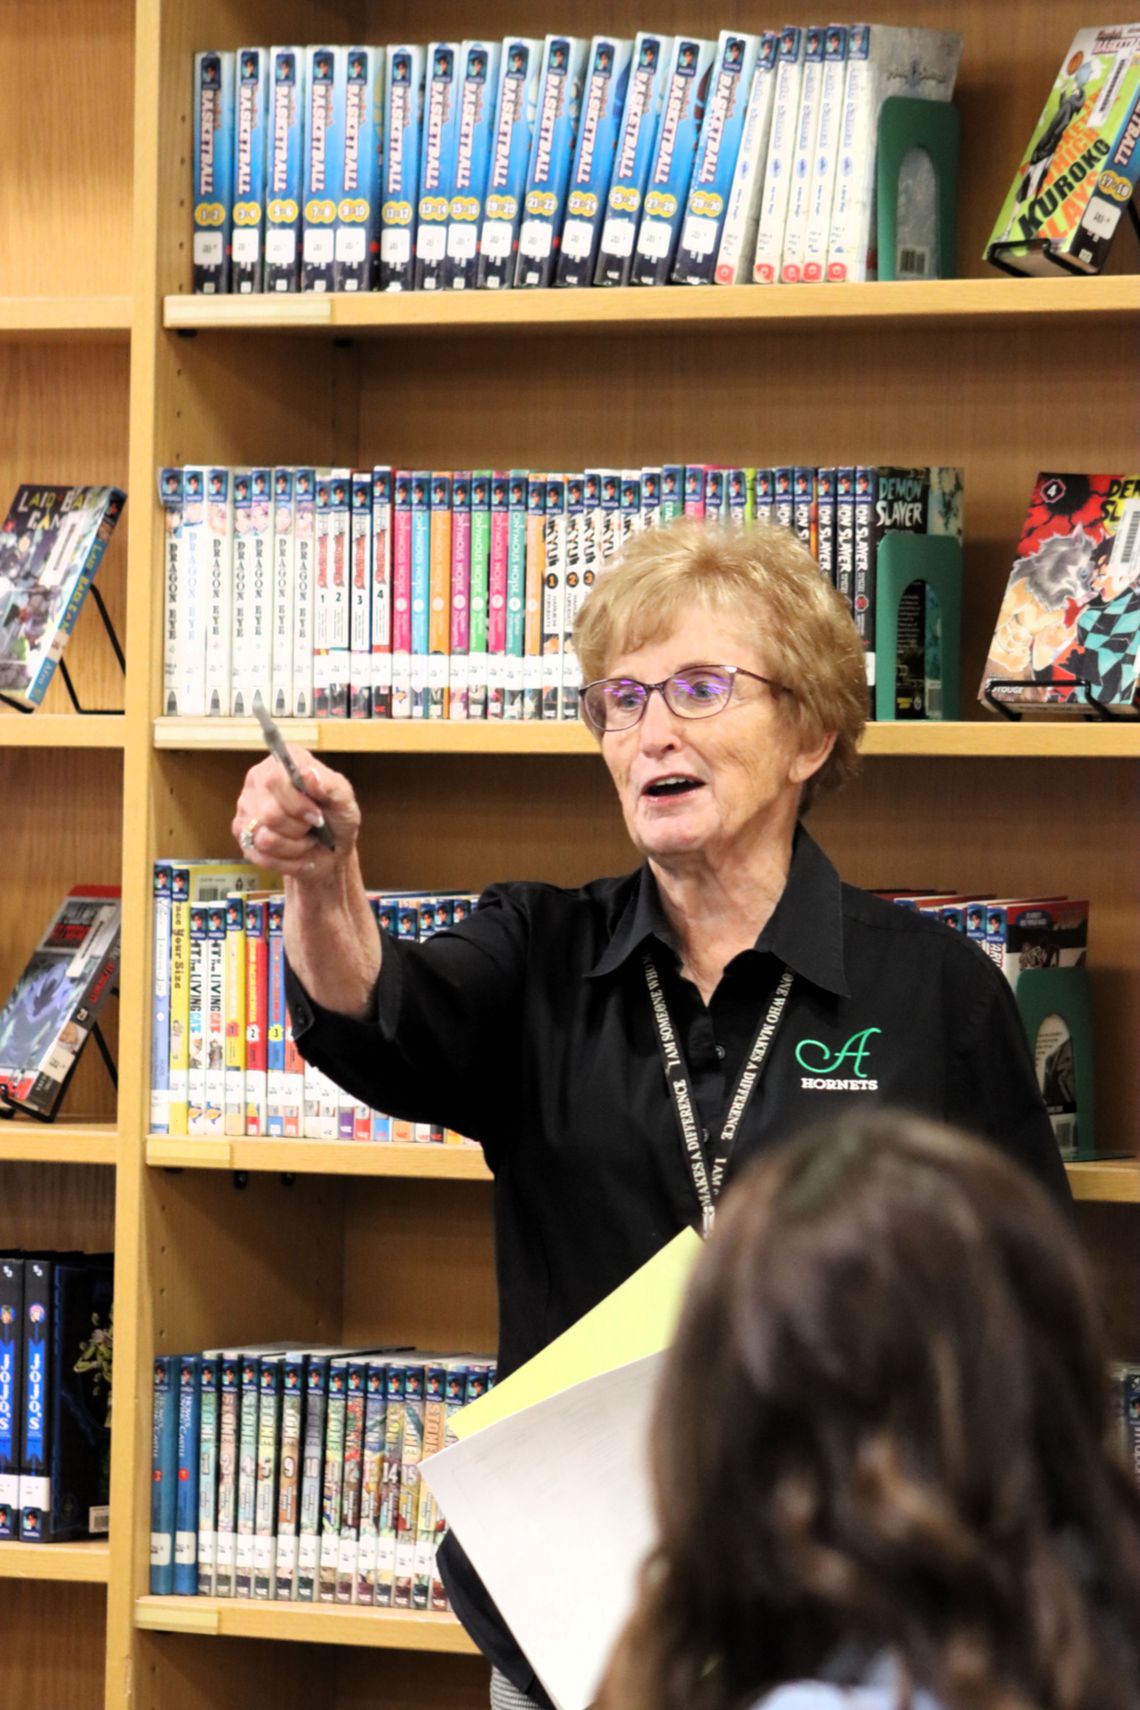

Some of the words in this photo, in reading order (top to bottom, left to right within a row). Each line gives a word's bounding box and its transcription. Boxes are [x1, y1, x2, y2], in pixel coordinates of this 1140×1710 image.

[200, 89, 214, 195] BASKETBALL
[238, 86, 252, 195] BASKETBALL
[274, 85, 289, 192] BASKETBALL
[311, 84, 326, 193] BASKETBALL
[344, 84, 360, 192] BASKETBALL
[389, 86, 404, 194] BASKETBALL
[426, 81, 445, 189] BASKETBALL
[456, 81, 478, 189] BASKETBALL
[493, 78, 518, 187] BASKETBALL
[534, 74, 561, 183] BASKETBALL
[577, 75, 604, 184] BASKETBALL
[618, 70, 648, 179] BASKETBALL
[653, 74, 686, 184] BASKETBALL
[698, 71, 733, 183] BASKETBALL
[1018, 138, 1111, 240] KUROKO
[876, 500, 922, 527] SLAYER
[879, 477, 922, 501] DEMON
[1047, 484, 1058, 497] 4
[211, 538, 221, 599] DRAGON
[236, 541, 246, 601] DRAGON
[254, 538, 264, 599] DRAGON
[299, 541, 308, 601] DRAGON
[818, 527, 832, 571] SLAYER
[838, 528, 852, 573] SLAYER
[855, 527, 869, 572] SLAYER
[173, 929, 185, 959] Your
[174, 960, 185, 990] Size
[190, 974, 202, 1011] LIVING
[210, 974, 222, 1011] LIVING
[190, 1012, 202, 1033] CAT
[210, 1012, 222, 1034] CAT
[650, 990, 674, 1042] SOMEONE
[766, 997, 786, 1023] WHO
[663, 1042, 680, 1059] AM
[746, 1061, 759, 1071] A
[749, 1023, 776, 1062] MAKES
[720, 1071, 757, 1141] DIFFERENCE
[800, 1077, 879, 1091] HORNETS
[673, 1079, 701, 1151] DIFFERENCE
[691, 1150, 703, 1160] A
[711, 1165, 724, 1186] AM
[691, 1162, 712, 1207] MAKES
[29, 1353, 42, 1430] JOJO'S
[179, 1425, 187, 1458] CASTLE
